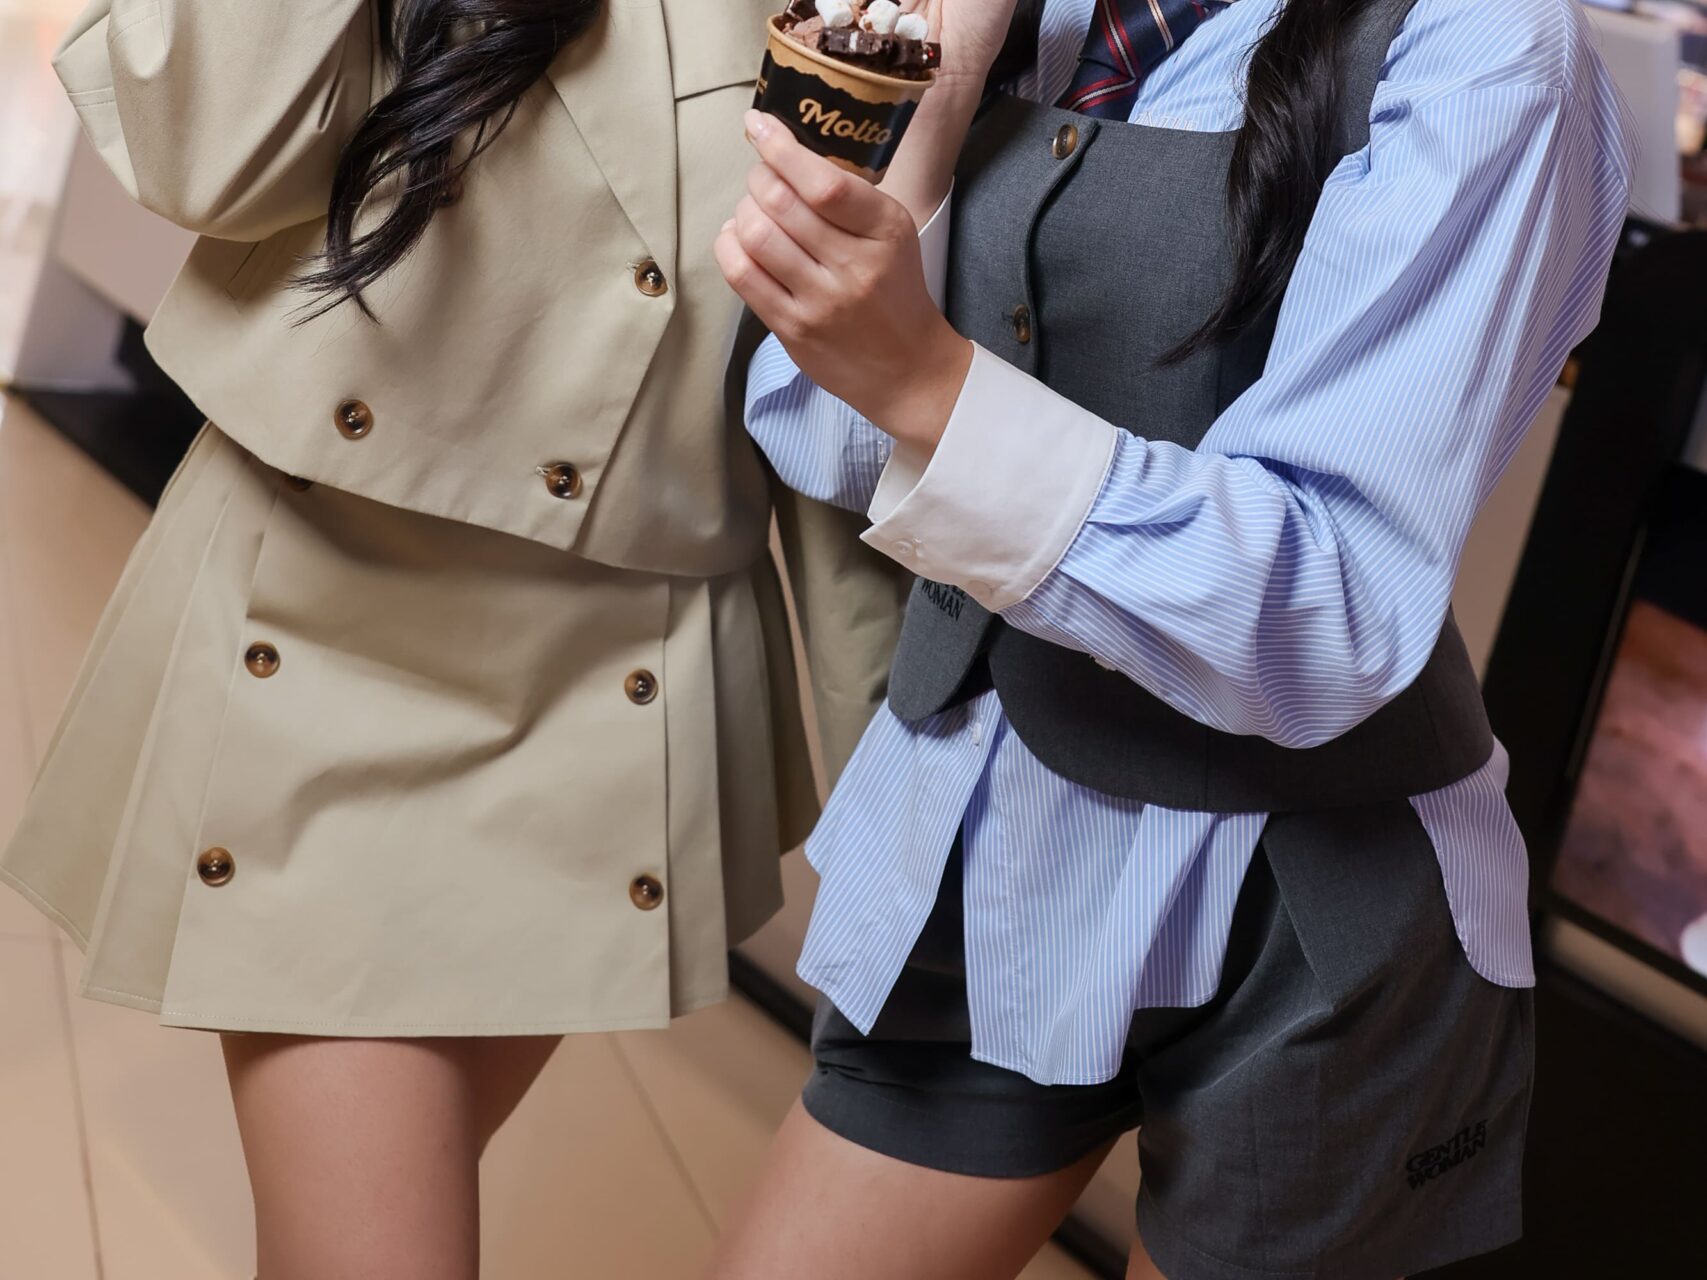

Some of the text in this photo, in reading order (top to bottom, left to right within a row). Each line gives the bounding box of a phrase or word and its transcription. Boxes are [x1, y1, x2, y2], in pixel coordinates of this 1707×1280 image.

[798, 97, 893, 145] Molto
[1406, 1119, 1488, 1173] GENTLE
[1407, 1130, 1487, 1191] WOMAN
